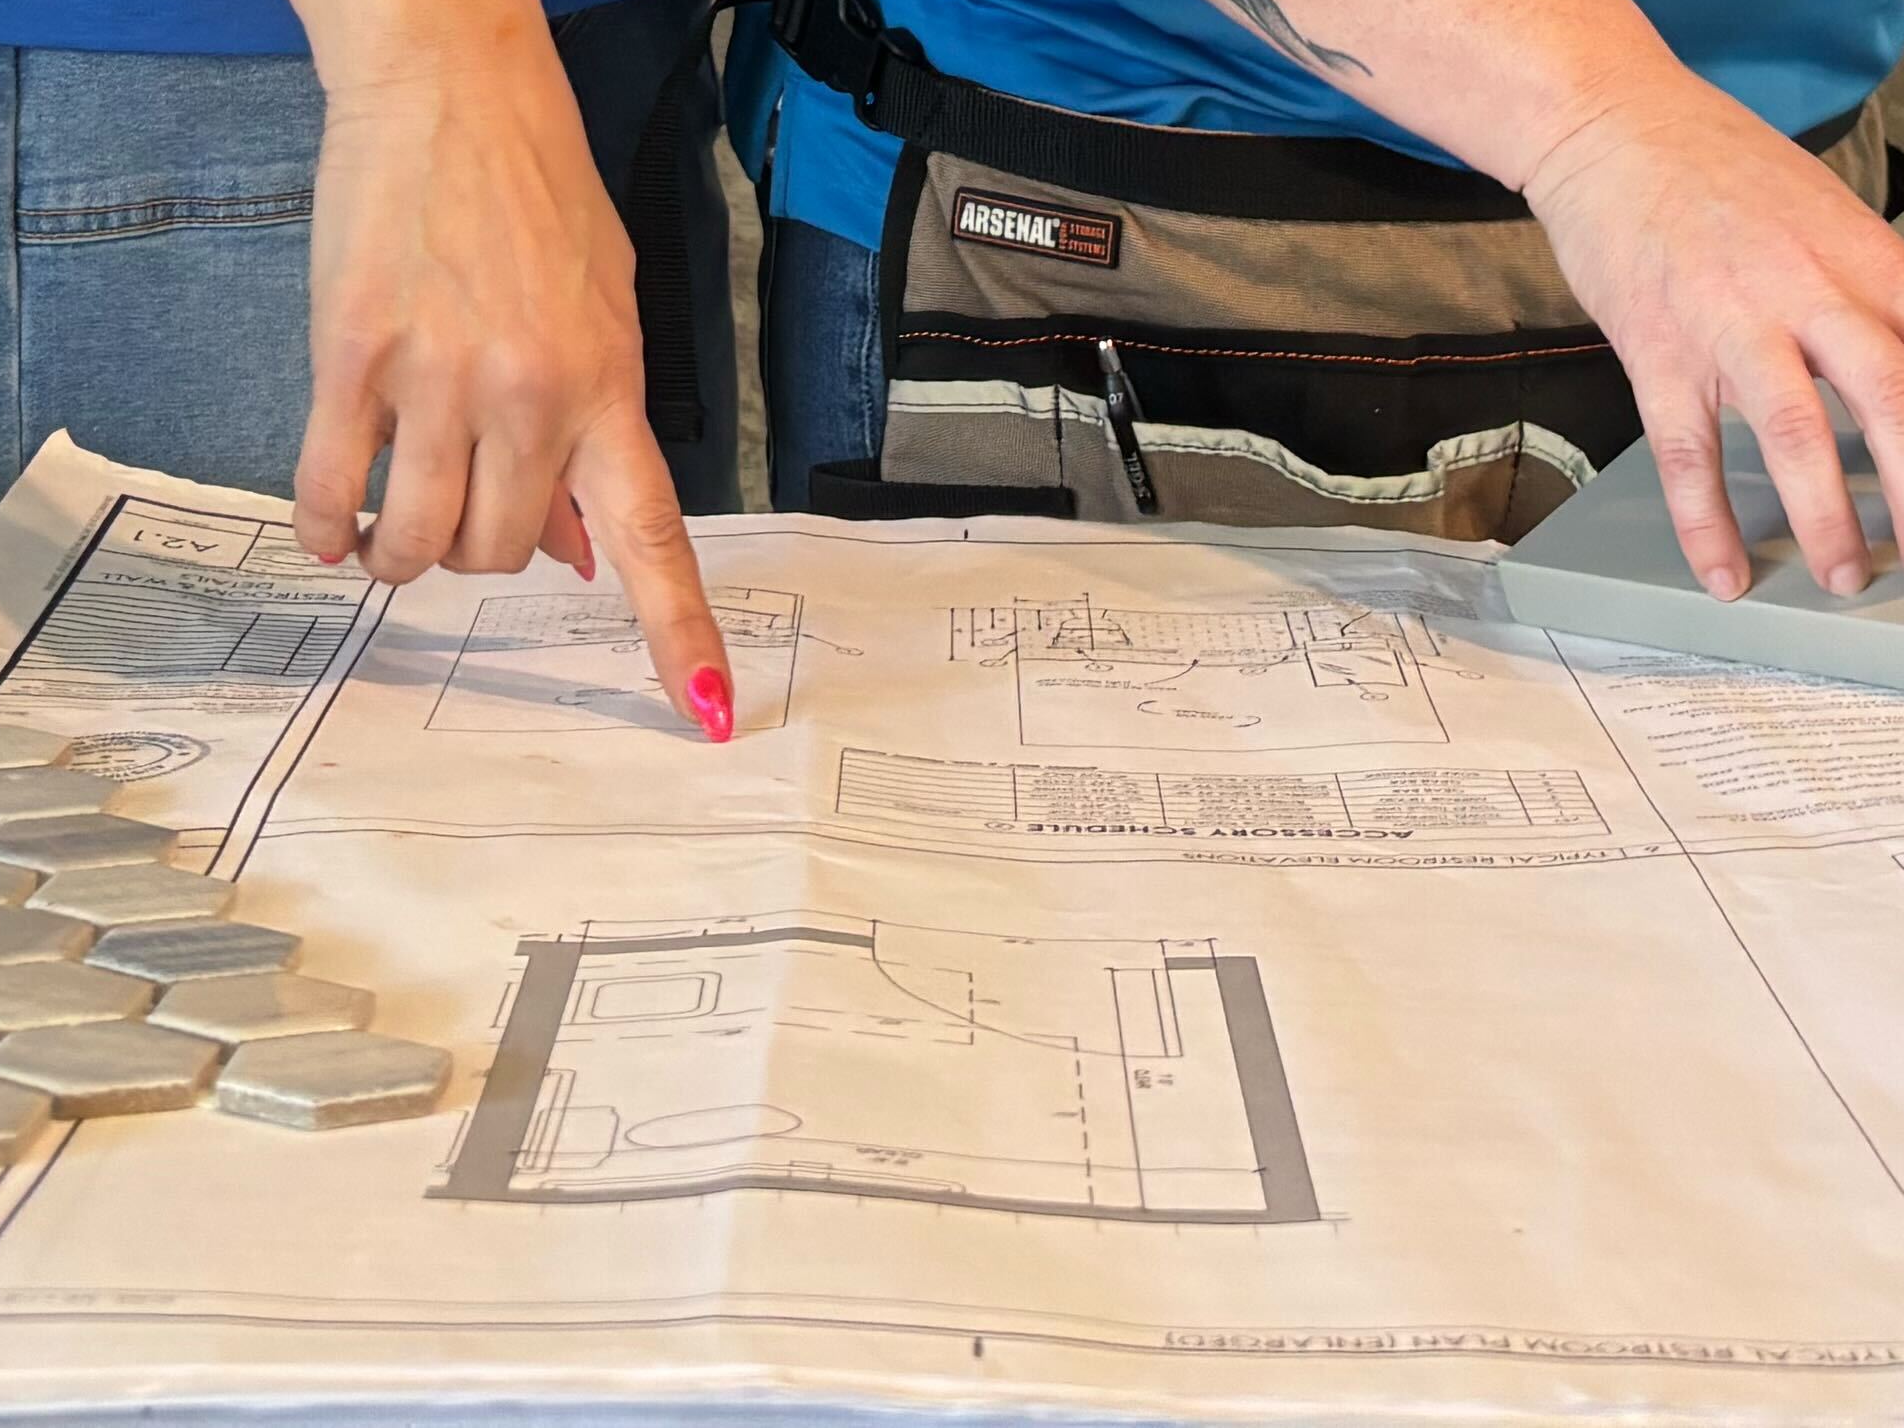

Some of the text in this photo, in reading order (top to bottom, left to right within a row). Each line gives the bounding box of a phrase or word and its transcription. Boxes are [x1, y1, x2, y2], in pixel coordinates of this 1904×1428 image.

[959, 201, 1057, 248] ARSENAL
[132, 529, 219, 554] A2.1
[100, 572, 167, 586] WALL
[178, 573, 275, 591] DETAILS
[203, 587, 346, 602] RESTROOM
[1026, 823, 1414, 840] ACCESSORY SCHEDULE
[1182, 851, 1340, 866] ELEVATIONS
[1349, 855, 1495, 866] RESTROOM
[1508, 851, 1608, 866] TYPICAL
[1411, 1333, 1512, 1350] PLAN
[1522, 1337, 1734, 1361] RESTROOM
[1751, 1346, 1898, 1363] TYPICAL
